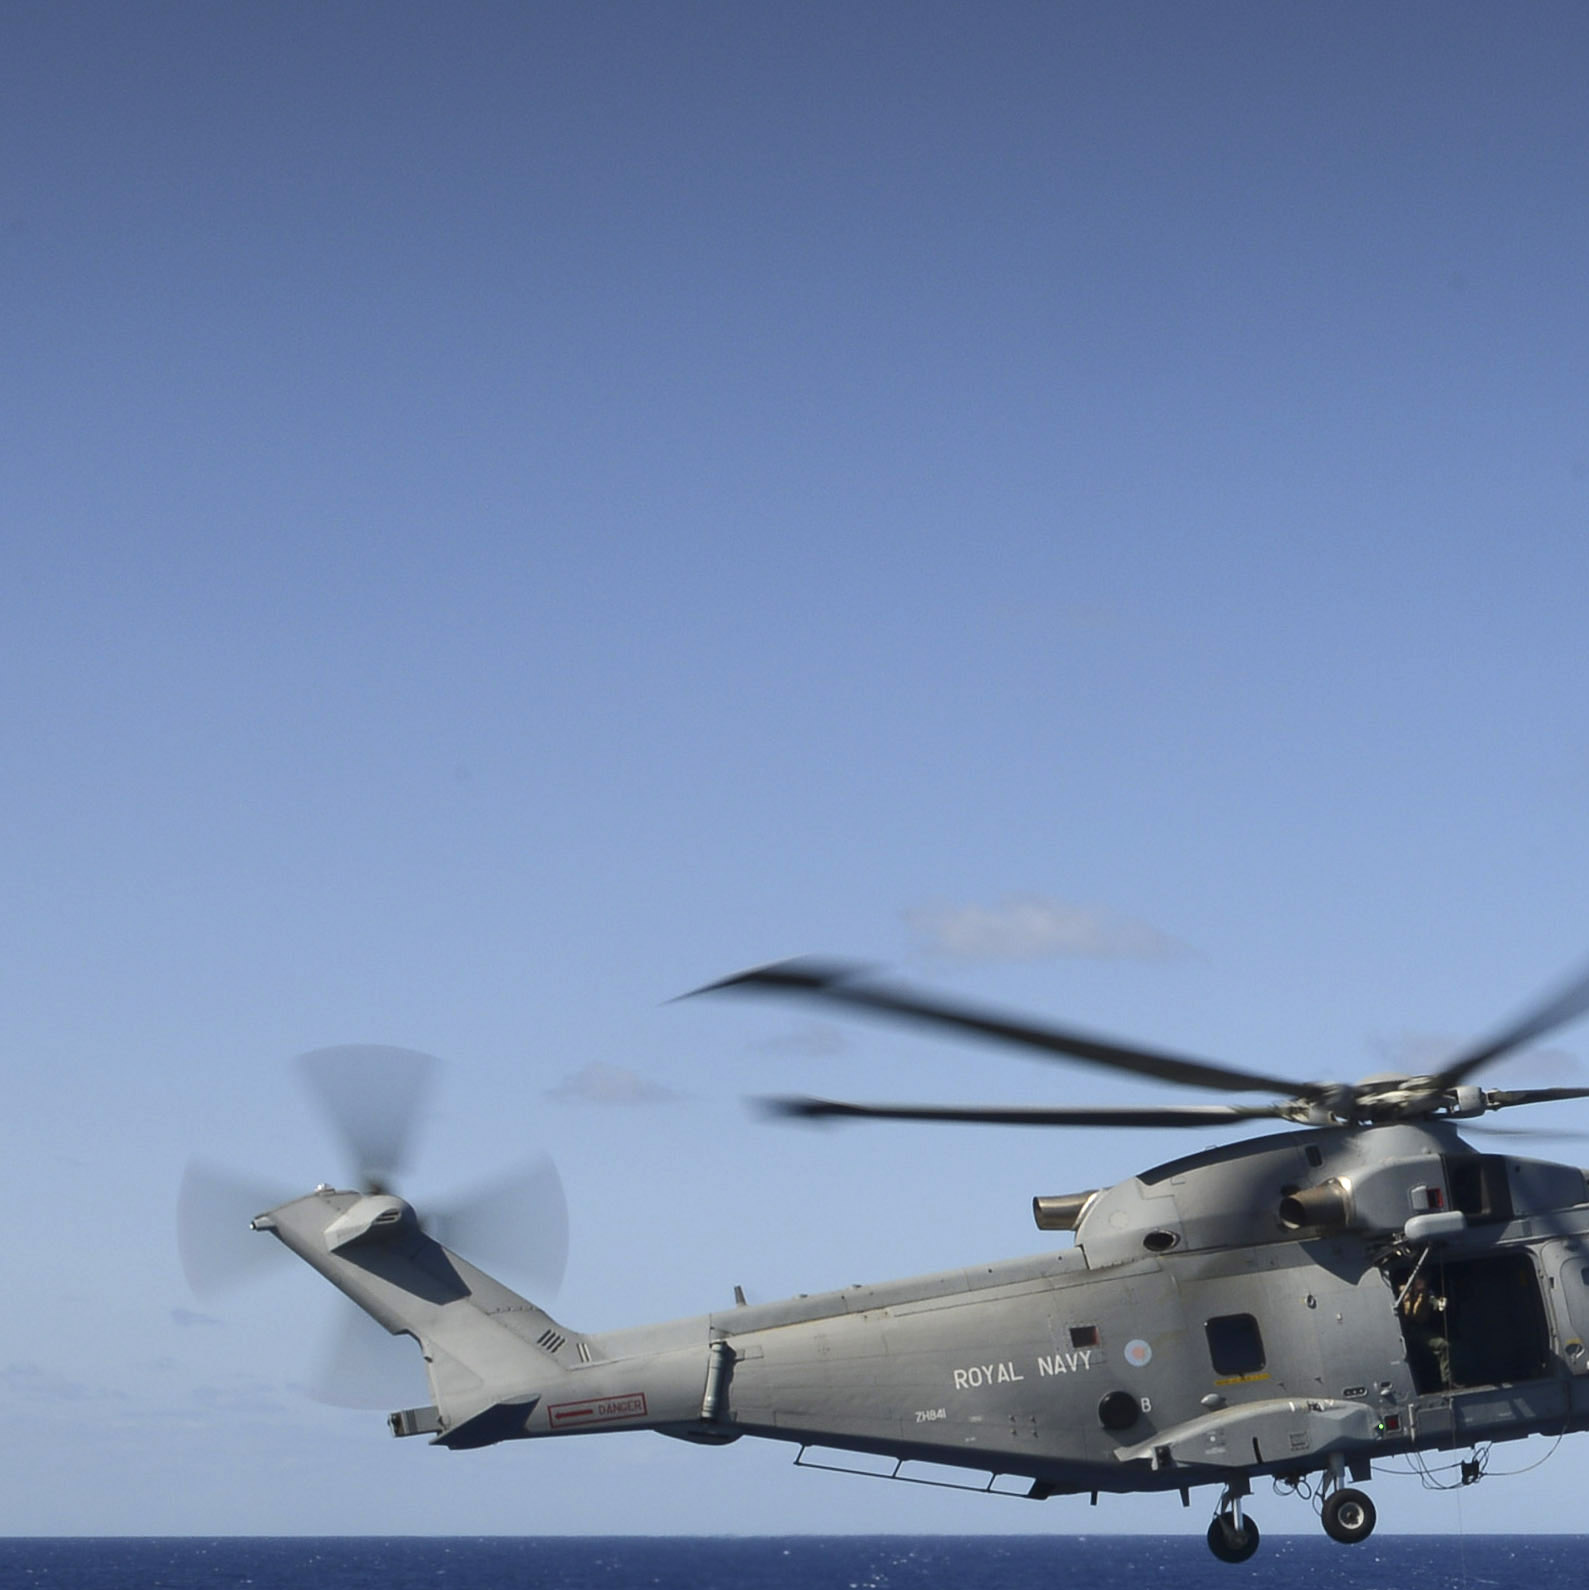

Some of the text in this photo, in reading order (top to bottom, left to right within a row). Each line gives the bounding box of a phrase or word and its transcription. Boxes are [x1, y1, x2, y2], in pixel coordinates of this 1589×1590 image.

[953, 1350, 1093, 1391] ROYAL NAVY
[598, 1399, 642, 1416] DANGER
[1140, 1397, 1152, 1413] B
